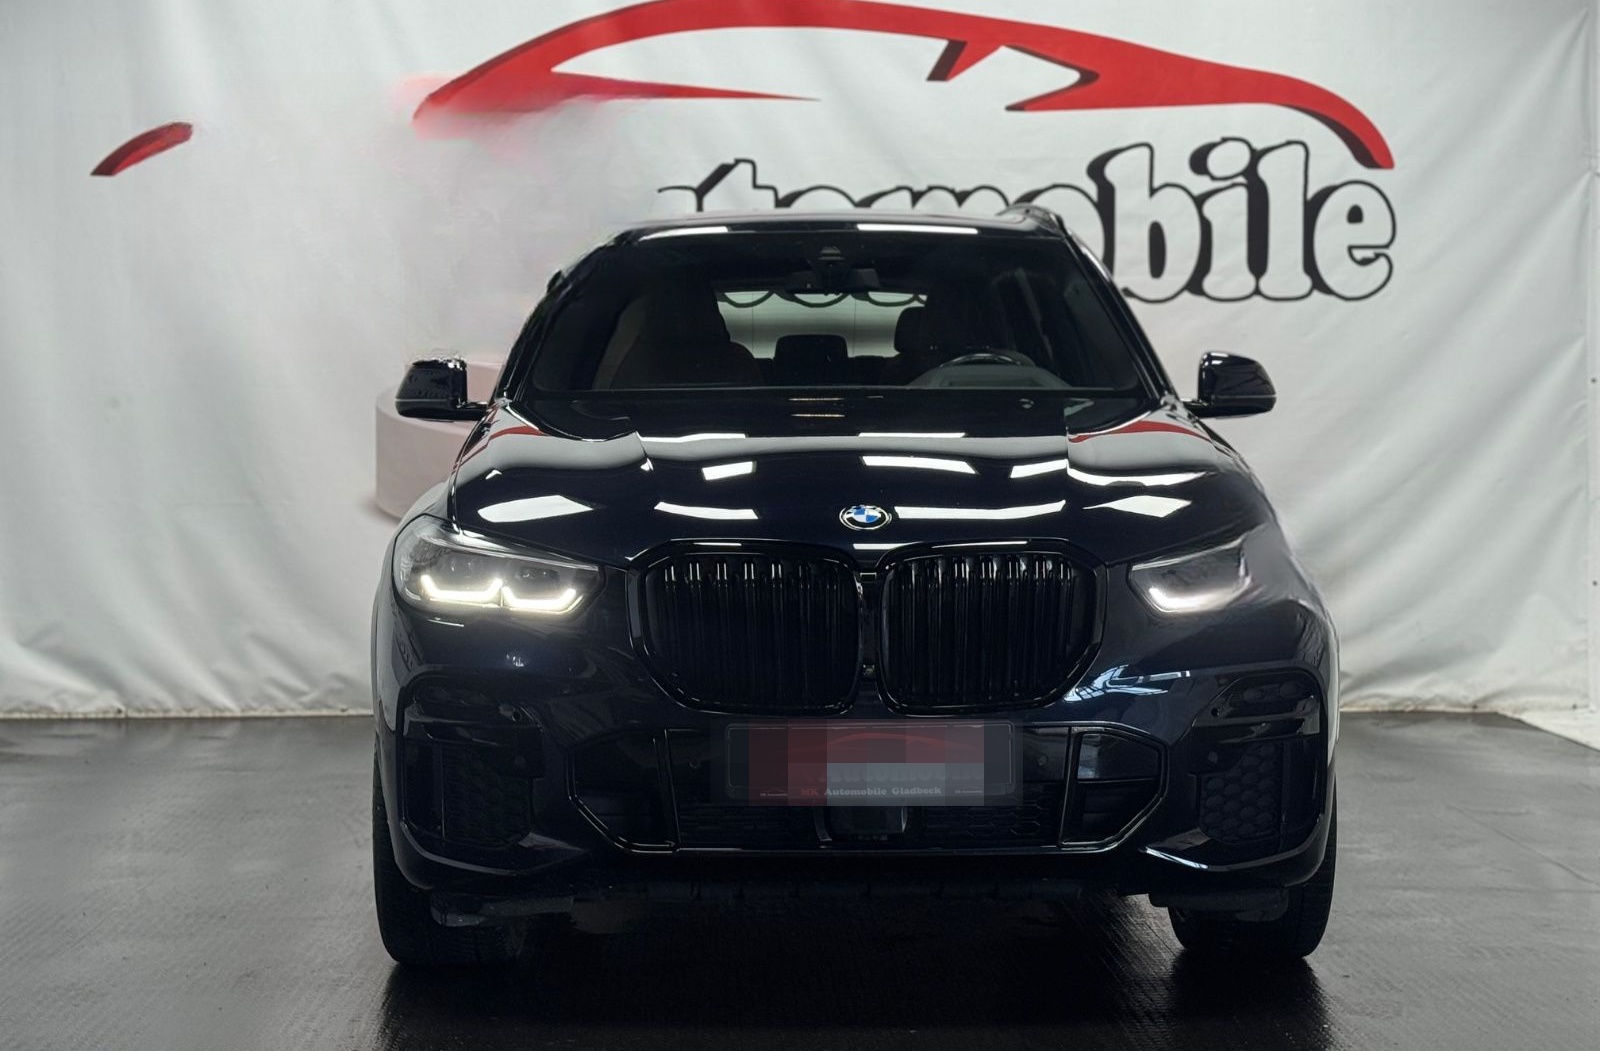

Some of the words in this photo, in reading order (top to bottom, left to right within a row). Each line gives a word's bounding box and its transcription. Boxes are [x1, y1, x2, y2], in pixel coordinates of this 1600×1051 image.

[801, 788, 819, 796] MK
[824, 787, 887, 796] Automobile
[891, 786, 942, 795] Gladbeck
